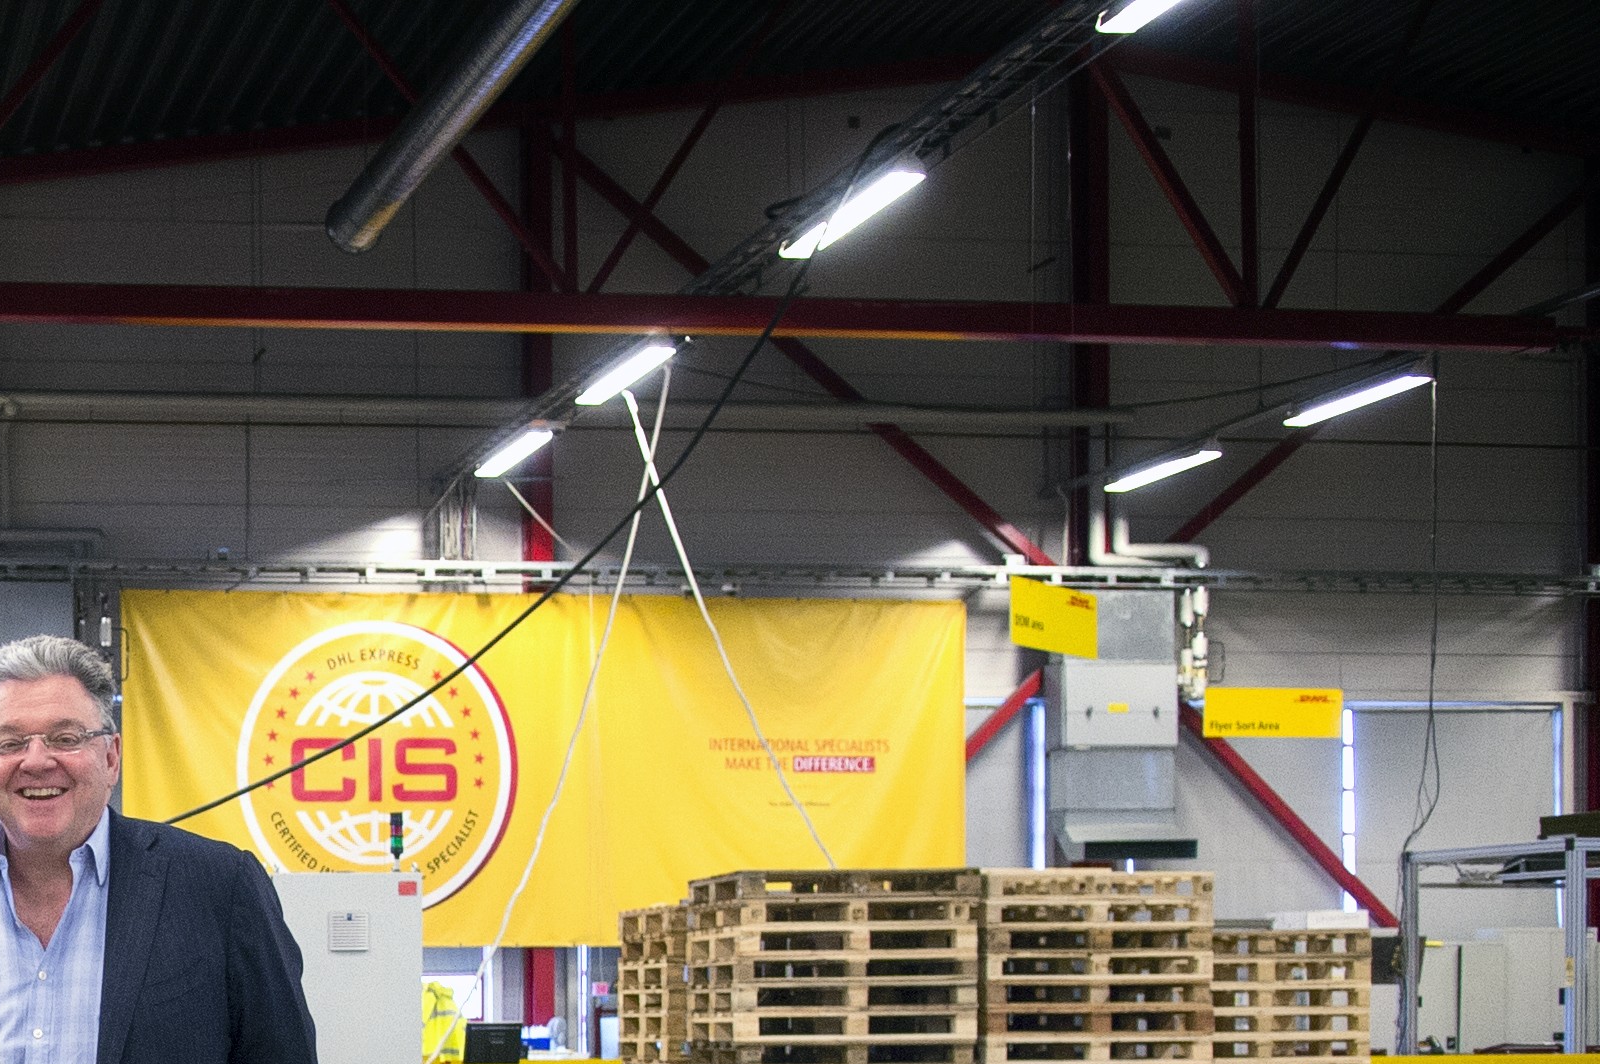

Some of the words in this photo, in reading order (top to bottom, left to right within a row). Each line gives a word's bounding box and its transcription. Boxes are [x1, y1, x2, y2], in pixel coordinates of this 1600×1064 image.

[326, 651, 356, 671] DHL
[360, 648, 422, 670] EXPRESS
[1258, 721, 1280, 730] Area
[814, 738, 891, 753] SPECIALISTS
[290, 737, 458, 802] CIS
[725, 757, 761, 770] MAKE
[270, 811, 318, 870] CERTIFIED
[427, 809, 480, 874] SPECIALIST
